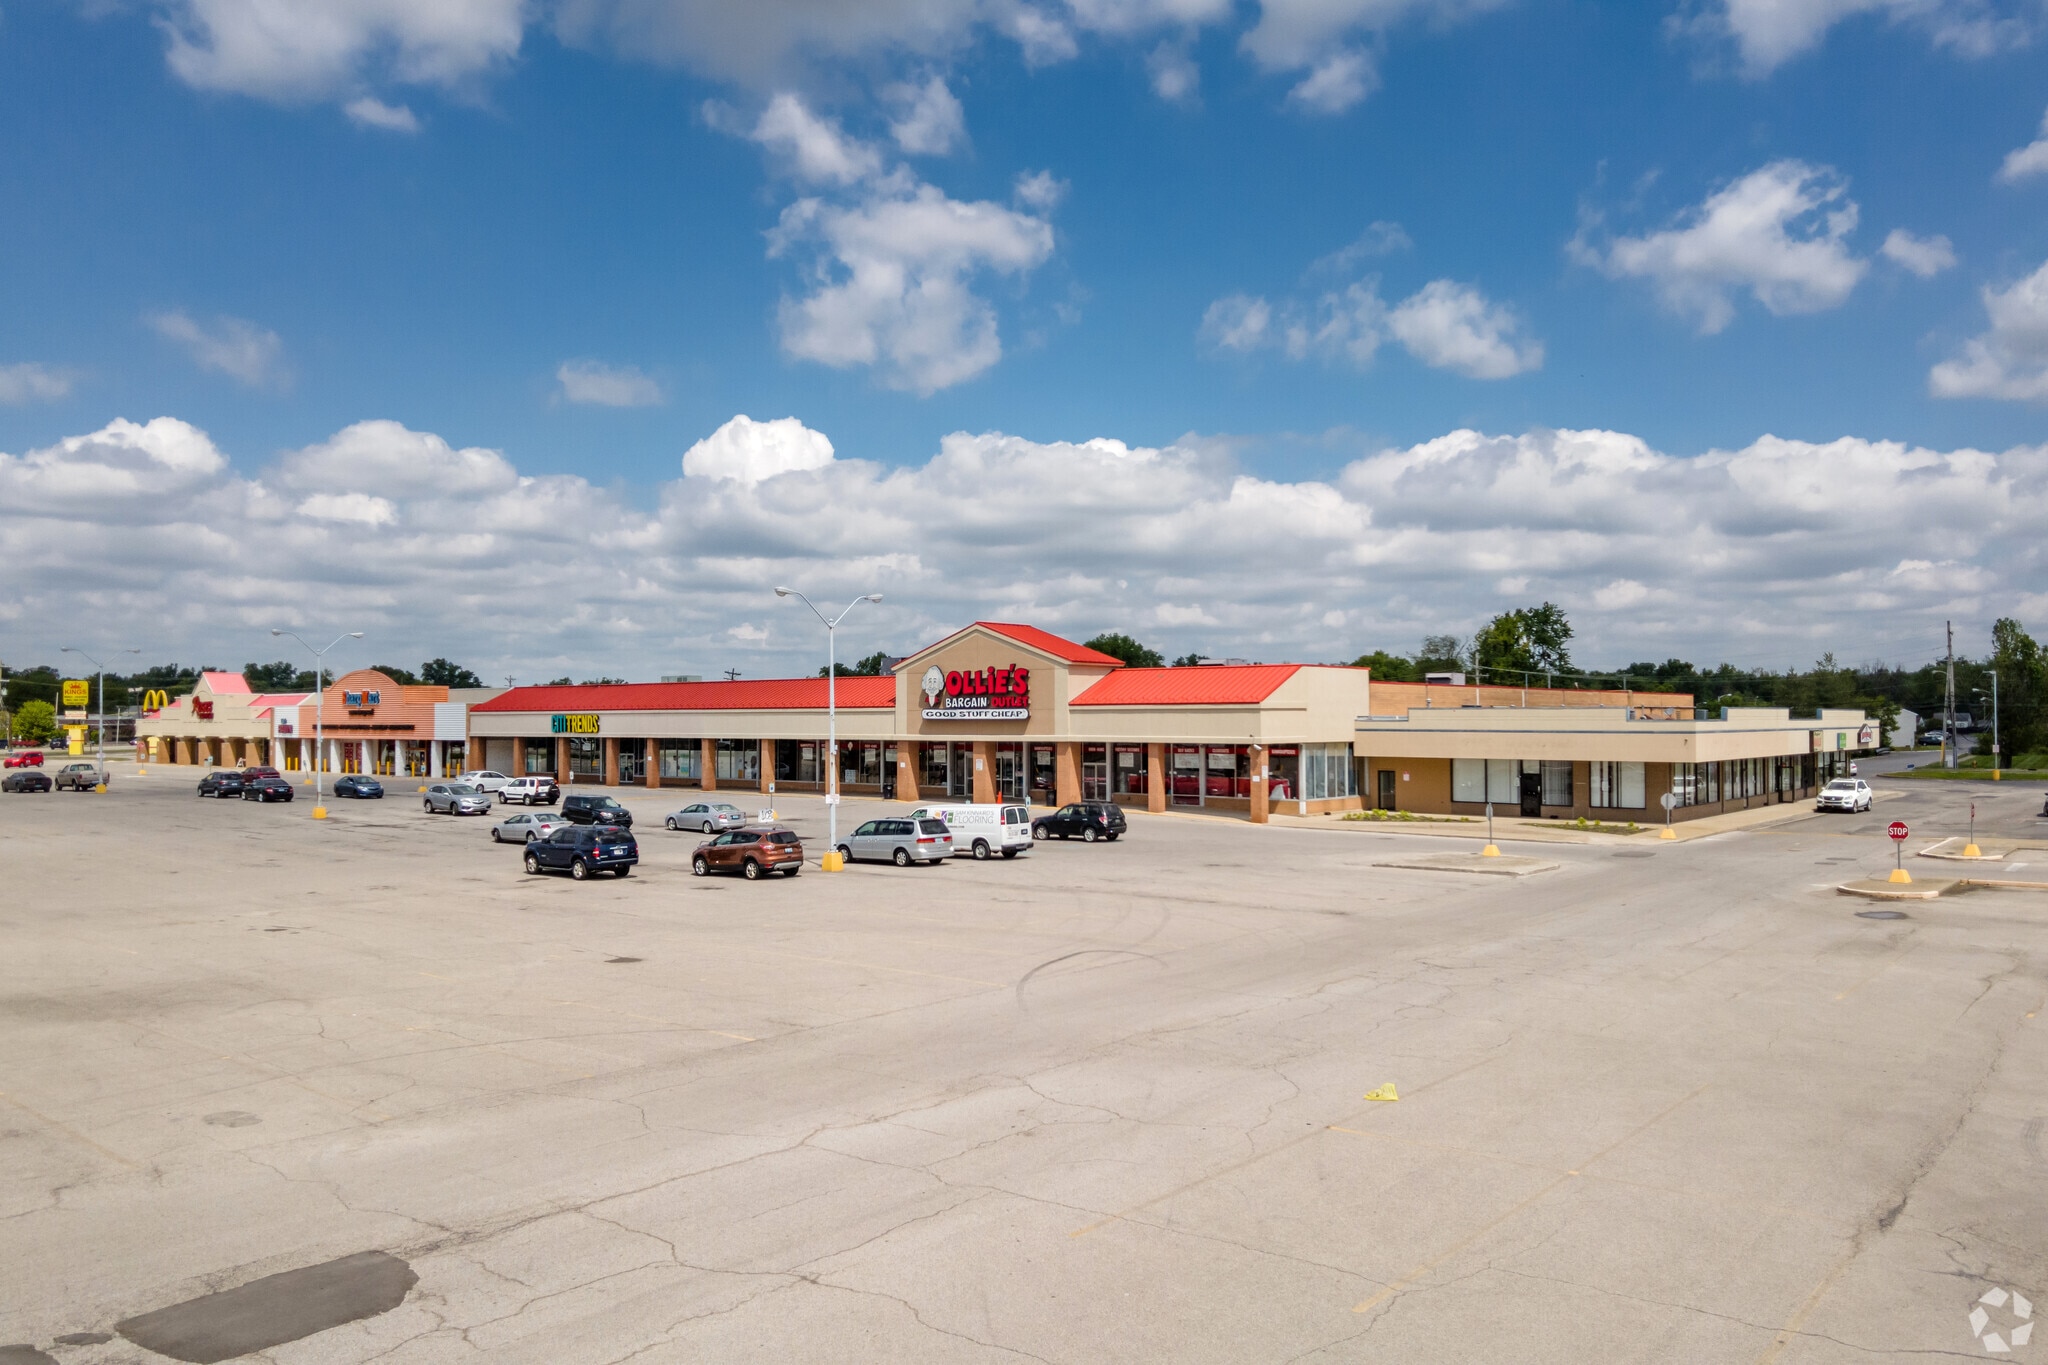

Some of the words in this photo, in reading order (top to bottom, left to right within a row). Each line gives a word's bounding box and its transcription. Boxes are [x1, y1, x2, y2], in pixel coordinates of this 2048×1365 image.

[945, 697, 988, 708] BARGAIN
[991, 696, 1029, 708] OUTLET
[954, 815, 994, 824] FLOORING
[1889, 827, 1908, 836] STOP
